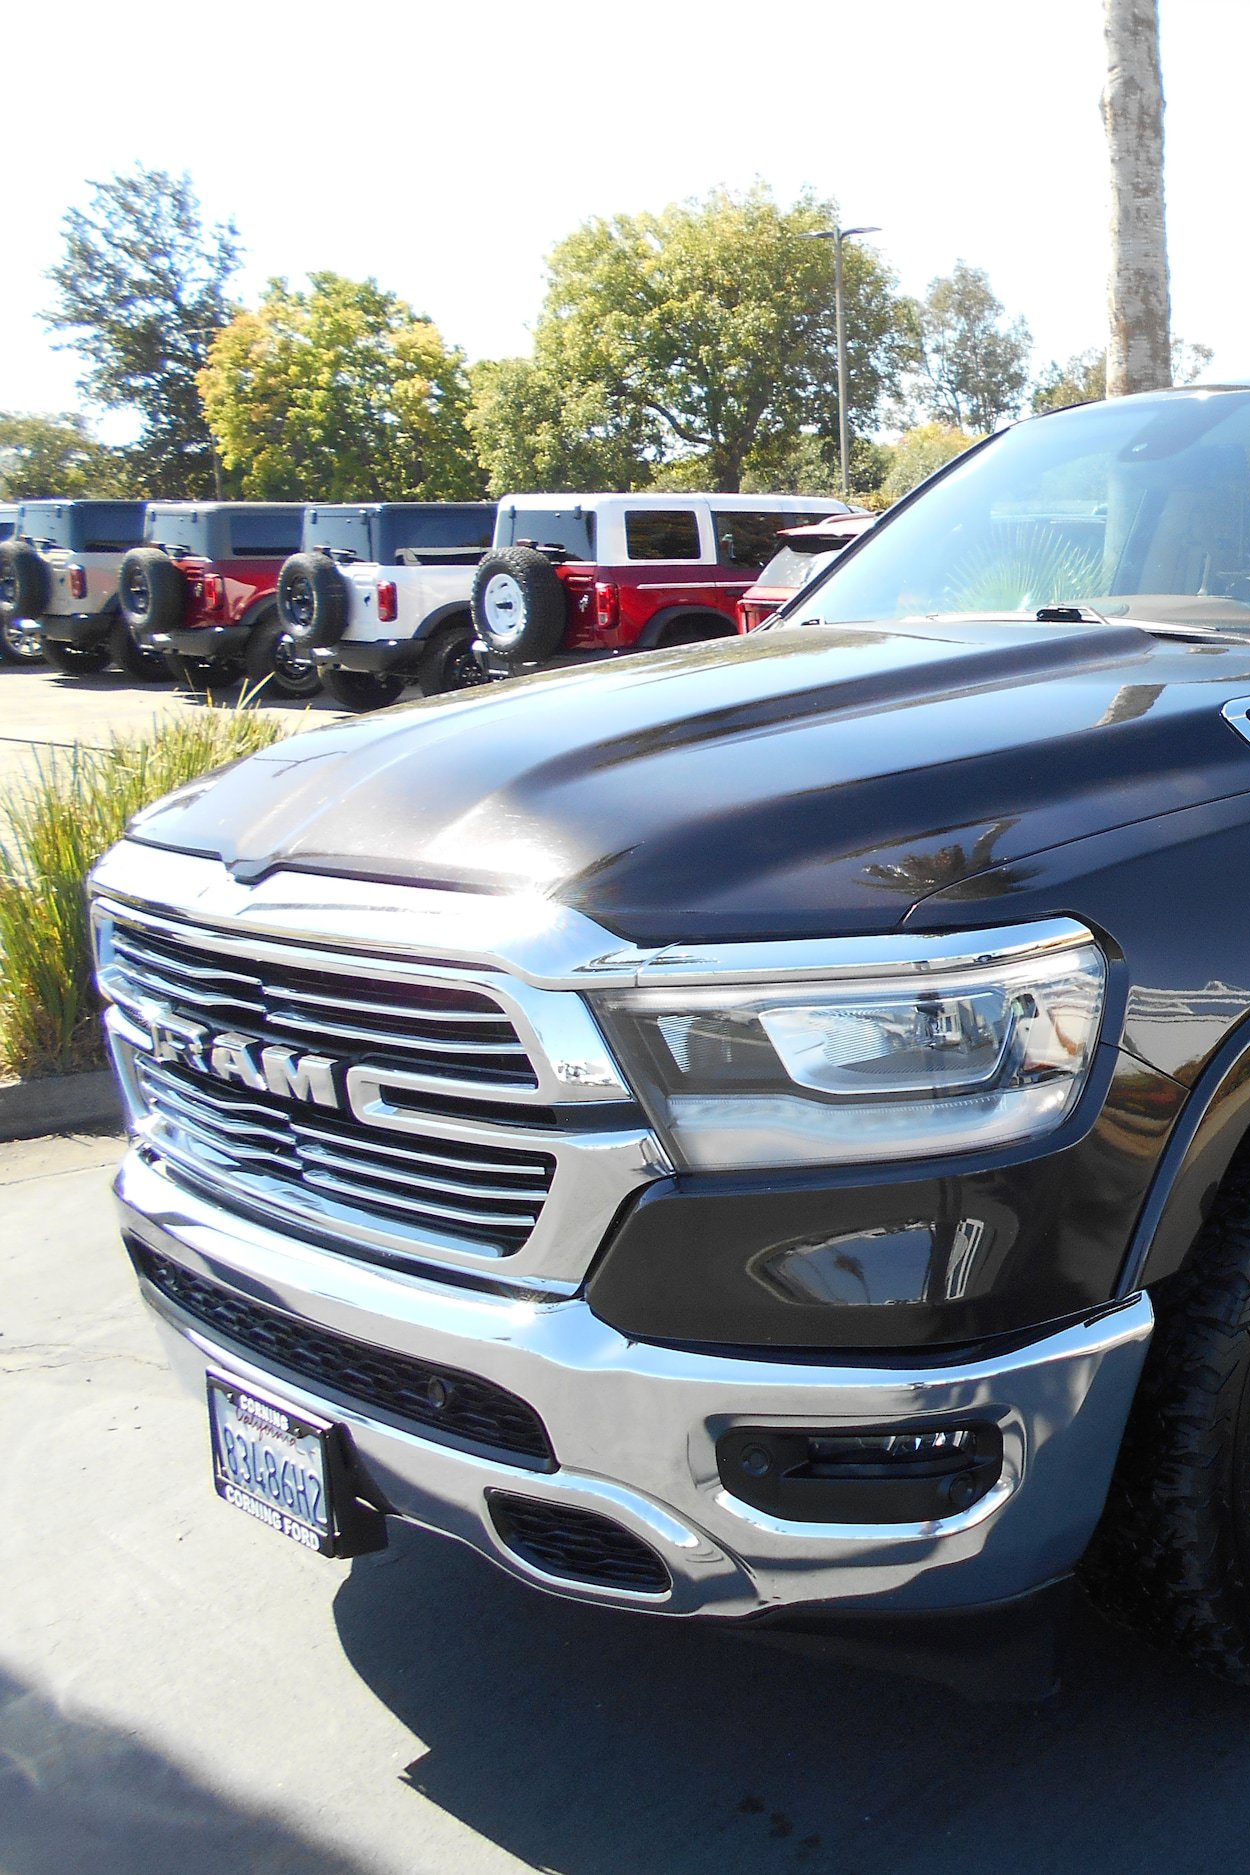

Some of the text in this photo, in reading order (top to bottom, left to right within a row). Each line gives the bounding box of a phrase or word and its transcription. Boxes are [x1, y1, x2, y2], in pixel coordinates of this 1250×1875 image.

[151, 1012, 341, 1110] RAM
[240, 1394, 289, 1432] CORNING
[225, 1484, 320, 1551] CORNING FORD
